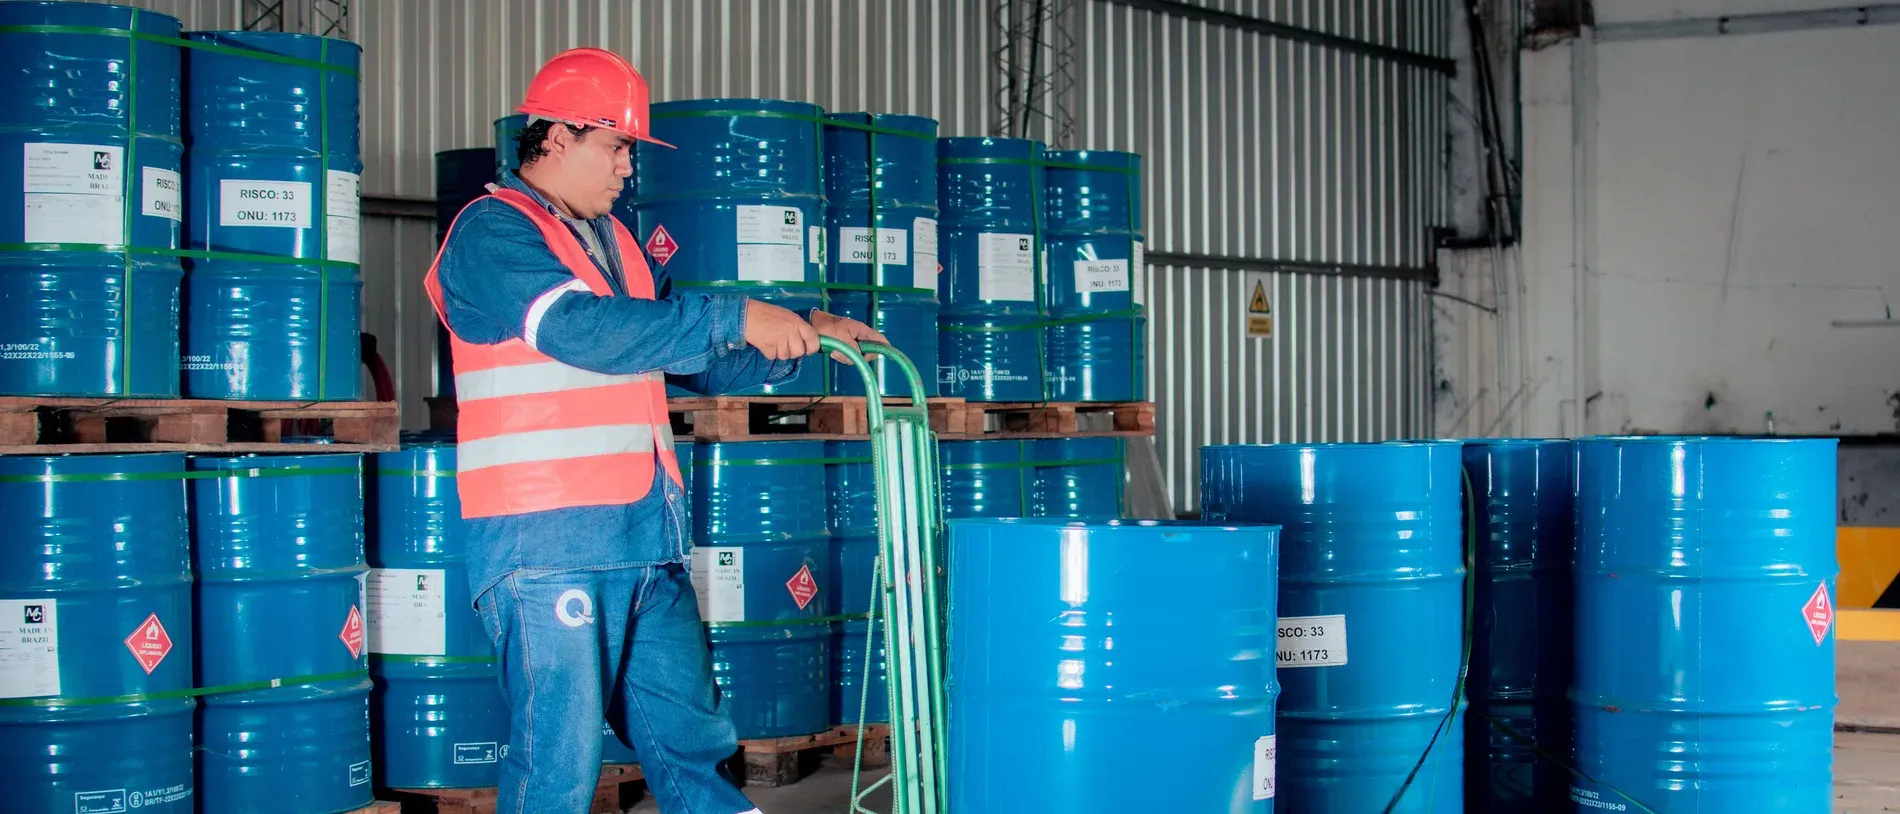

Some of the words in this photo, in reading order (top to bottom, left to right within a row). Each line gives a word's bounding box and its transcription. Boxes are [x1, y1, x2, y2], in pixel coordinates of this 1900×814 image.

[240, 189, 279, 199] RISCO:
[282, 191, 294, 200] 33
[237, 211, 267, 221] ONU:
[272, 212, 296, 221] 1173
[1310, 627, 1324, 636] 33
[1300, 650, 1328, 660] 1173
